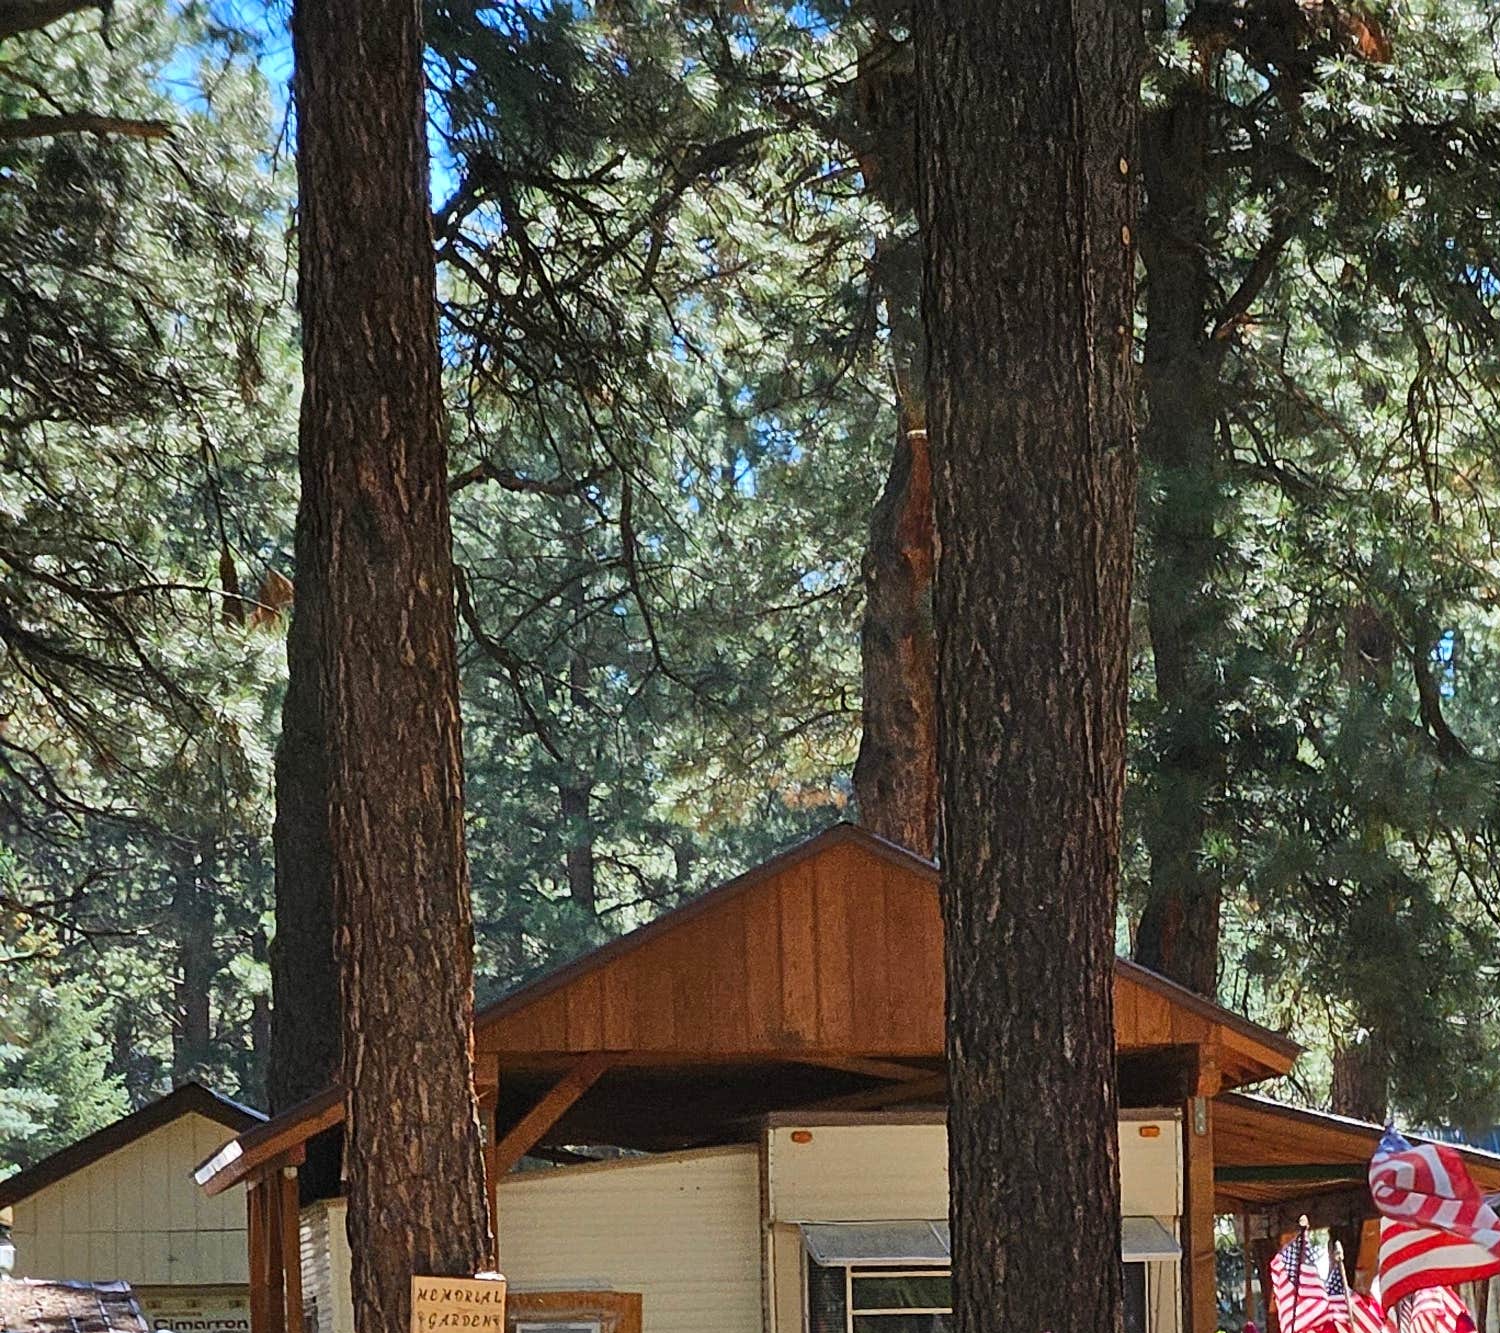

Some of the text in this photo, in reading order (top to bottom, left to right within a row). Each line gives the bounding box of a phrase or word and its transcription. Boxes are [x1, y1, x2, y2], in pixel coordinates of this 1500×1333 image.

[416, 1288, 503, 1305] MEMORIAL
[153, 1318, 249, 1330] Cimarron
[428, 1312, 491, 1330] GARDEN
